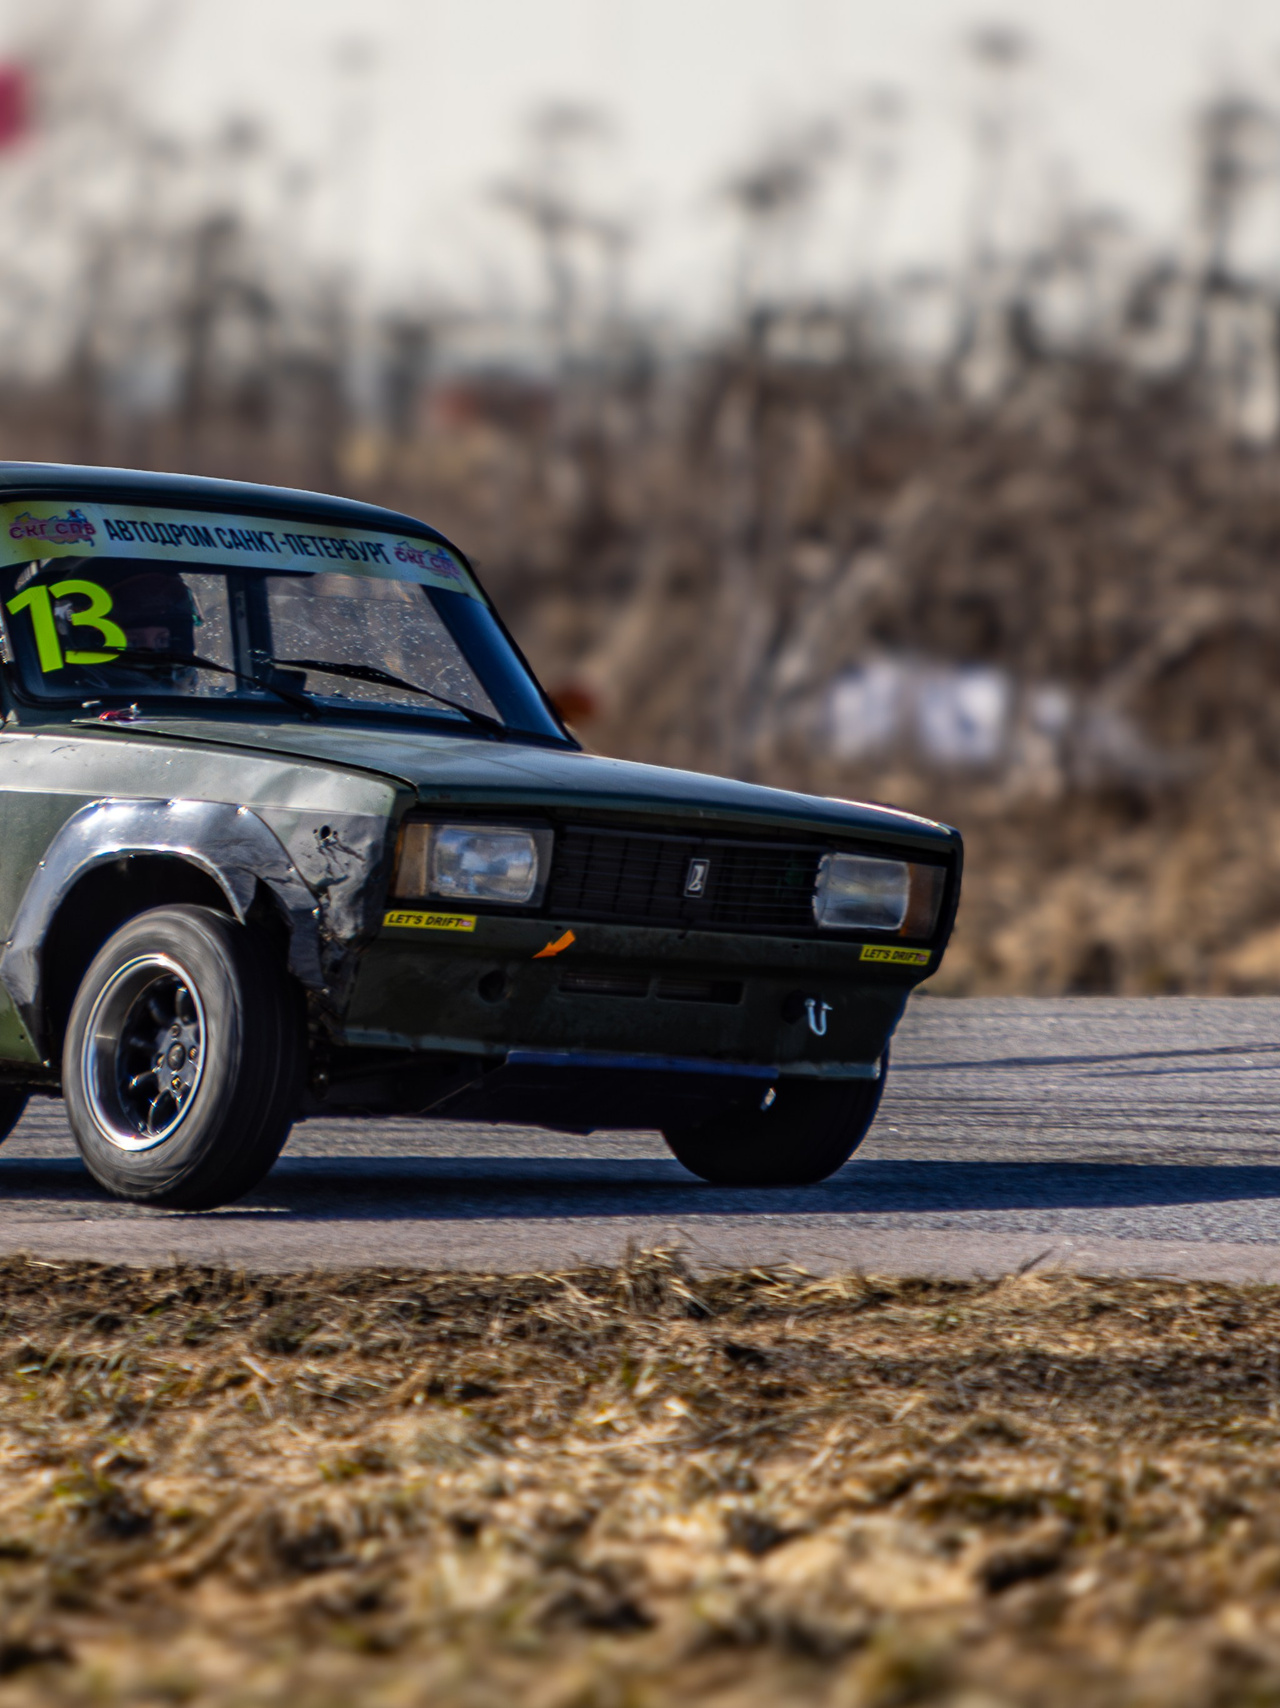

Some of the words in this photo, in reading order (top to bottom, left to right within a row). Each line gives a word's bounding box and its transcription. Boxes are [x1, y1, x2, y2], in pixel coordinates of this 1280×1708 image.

[103, 518, 217, 549] АВТОДРОМ
[218, 526, 392, 565] САНКТ-ПЕТЕРБУРГ
[6, 579, 128, 673] 13
[388, 914, 423, 925] LET'S
[425, 916, 462, 927] DRIFT
[864, 949, 891, 959] LET'S
[891, 951, 919, 961] DRIFT
